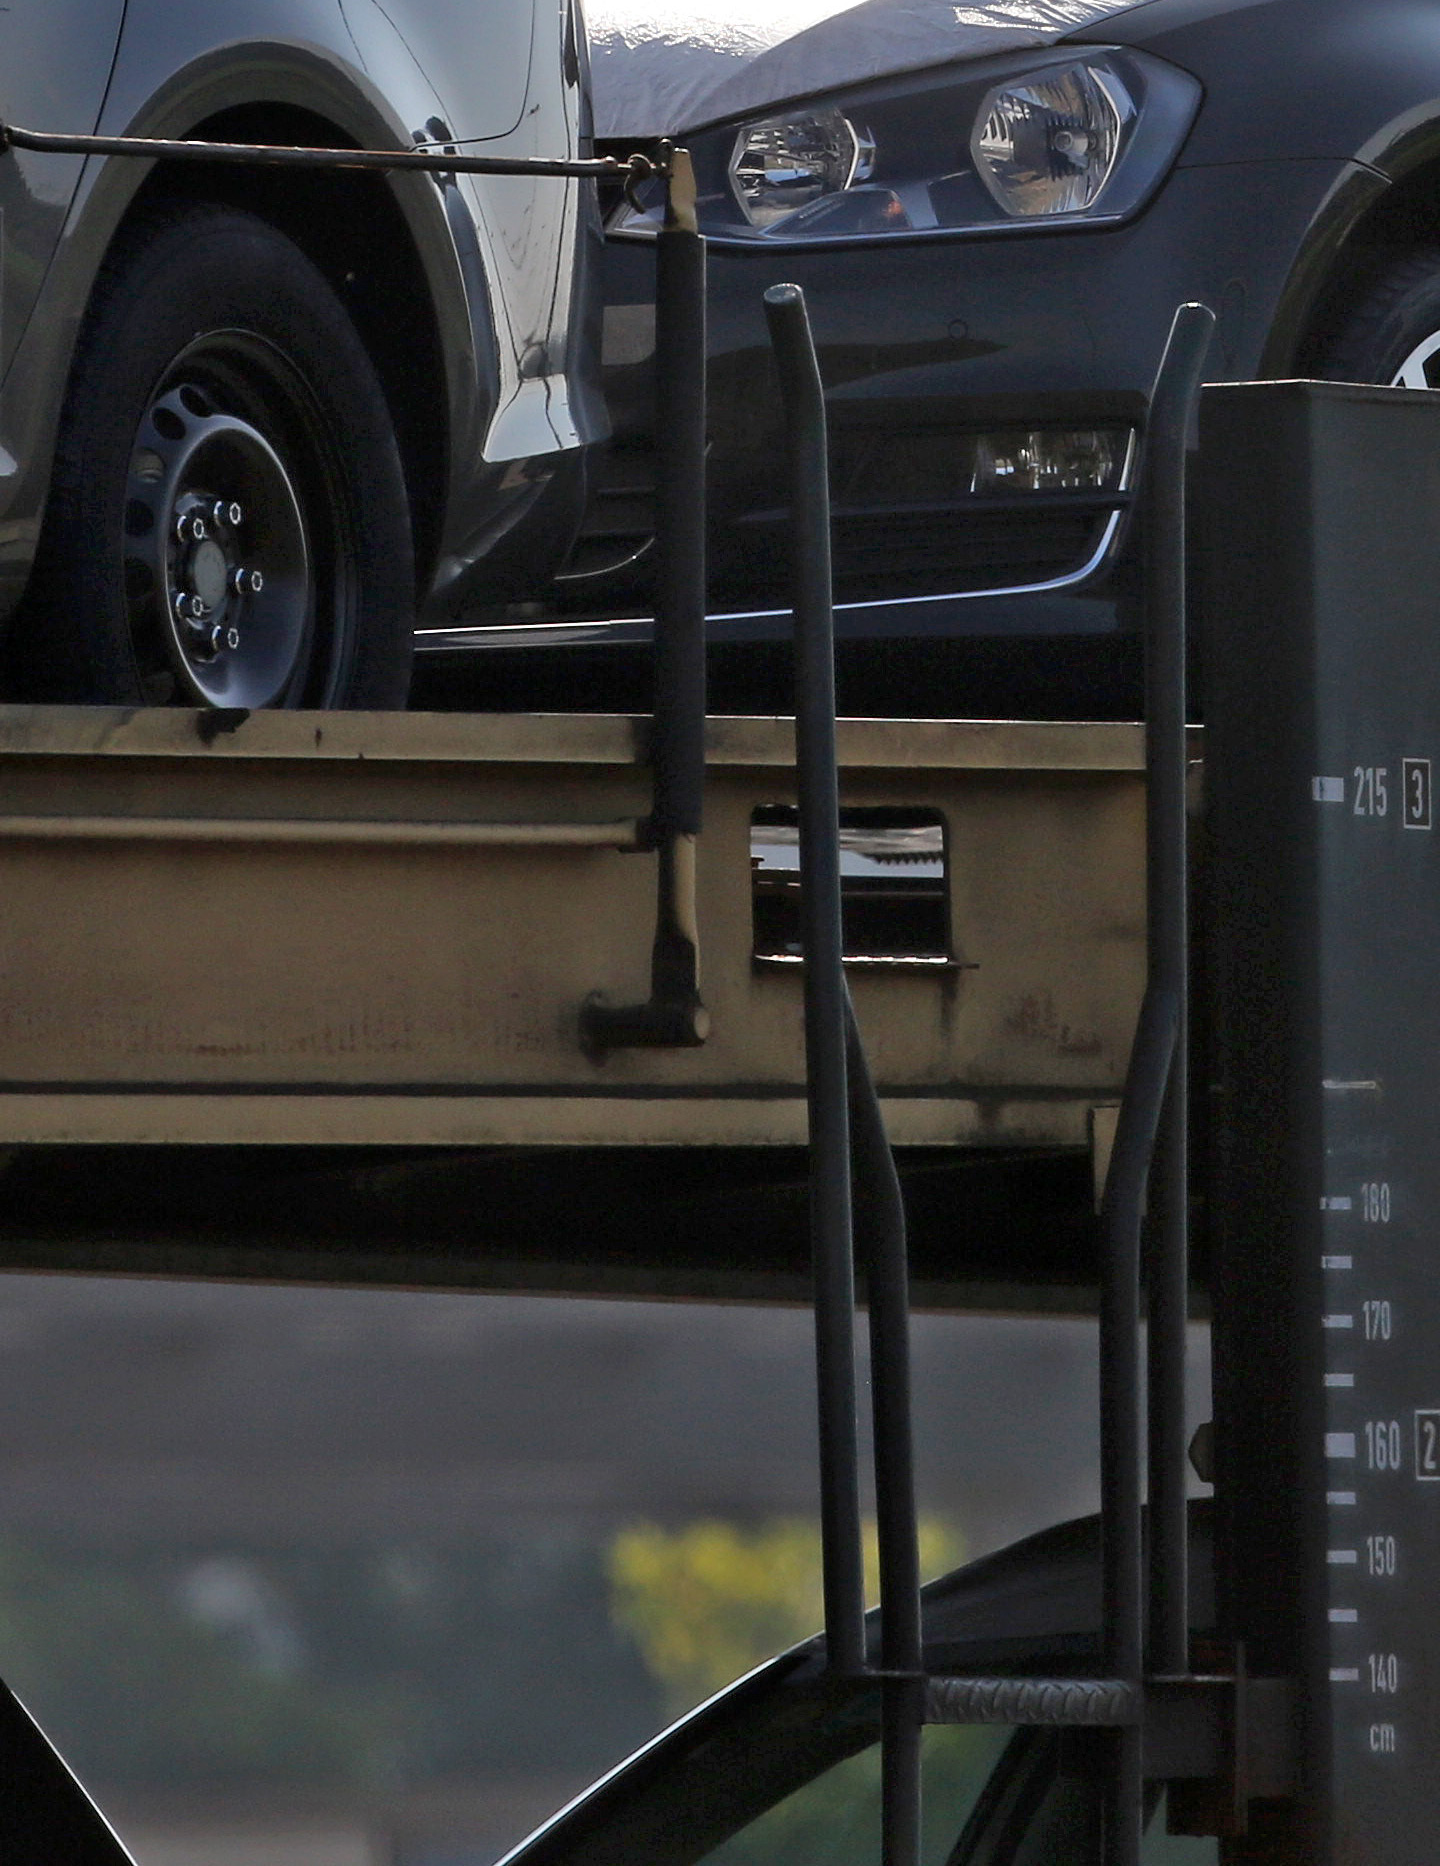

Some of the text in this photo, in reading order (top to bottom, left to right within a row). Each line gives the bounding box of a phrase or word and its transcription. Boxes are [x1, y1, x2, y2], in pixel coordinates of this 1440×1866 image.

[1354, 766, 1423, 818] 215 3
[1361, 1183, 1390, 1222] 180
[1363, 1301, 1391, 1340] 170
[1365, 1421, 1436, 1470] 160 2
[1367, 1536, 1396, 1575] 150
[1369, 1654, 1398, 1693] 140
[1370, 1724, 1395, 1752] cm
